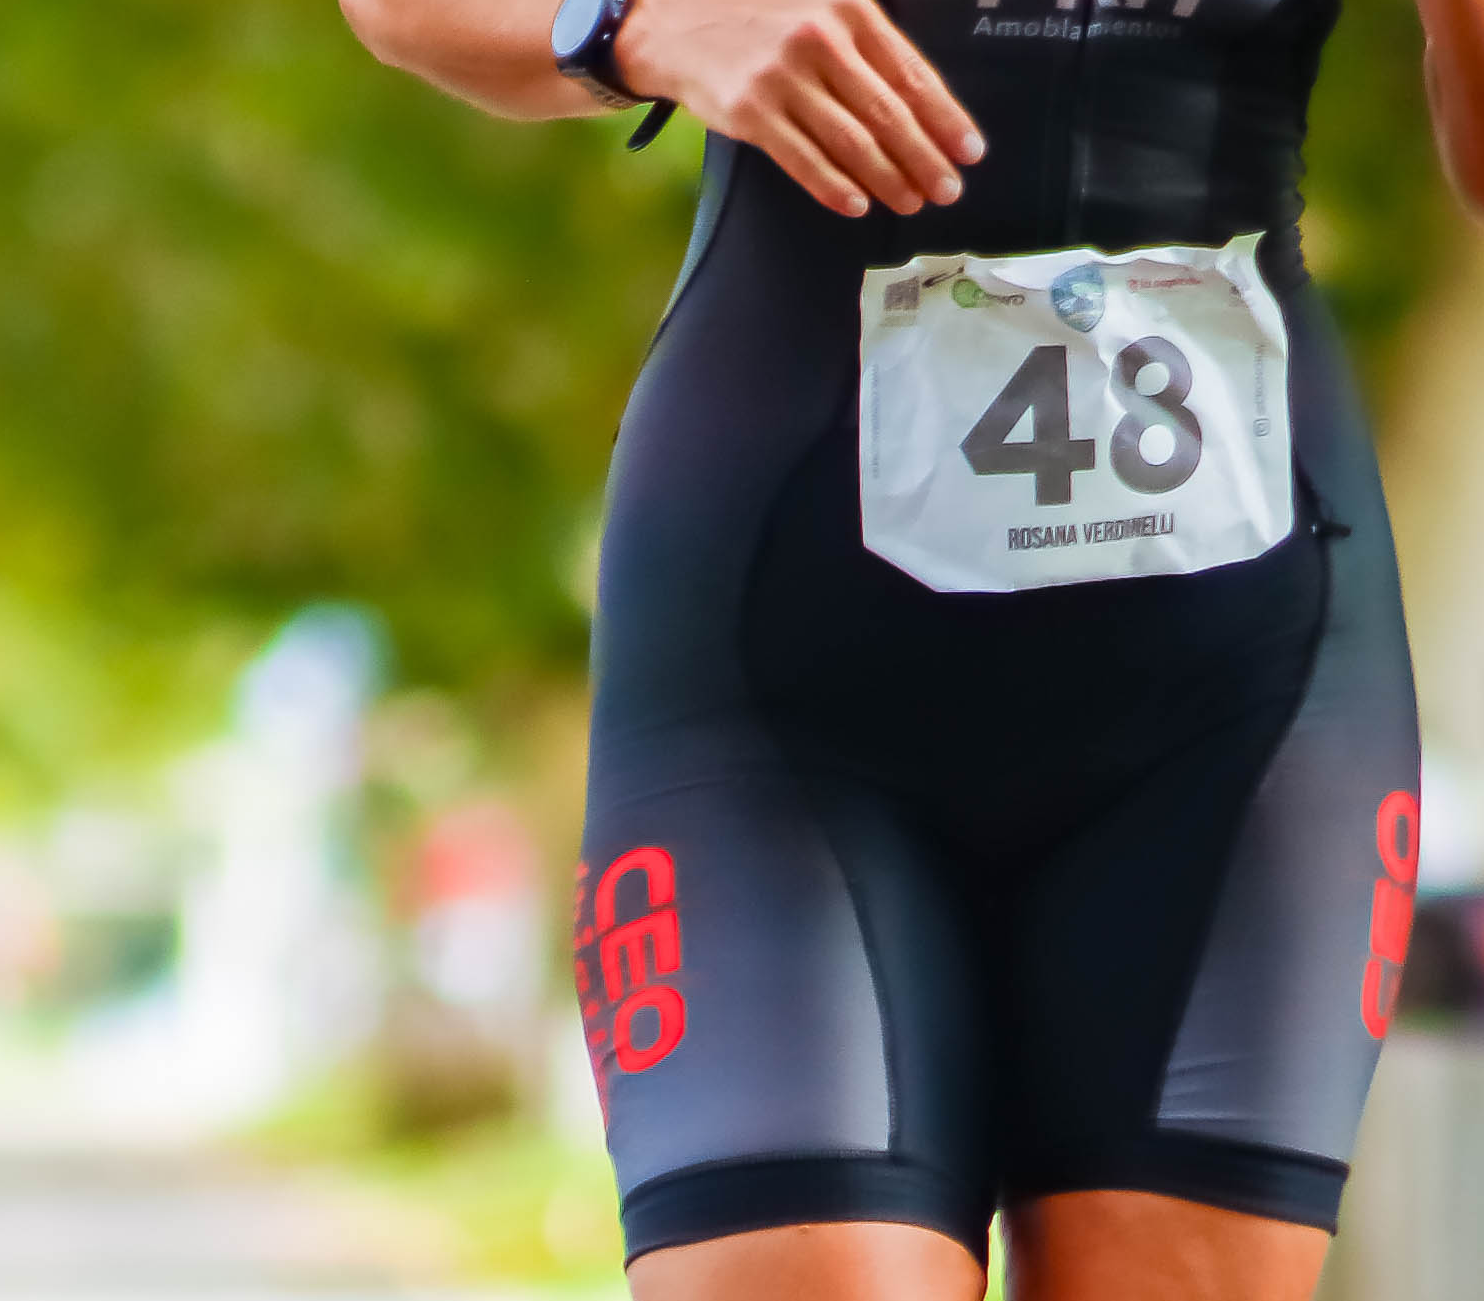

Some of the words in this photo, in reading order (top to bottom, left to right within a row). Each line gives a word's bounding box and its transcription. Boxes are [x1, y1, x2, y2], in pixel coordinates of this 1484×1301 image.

[959, 335, 1203, 506] 48
[1007, 523, 1079, 551] ROSANA
[594, 846, 686, 1074] CEO
